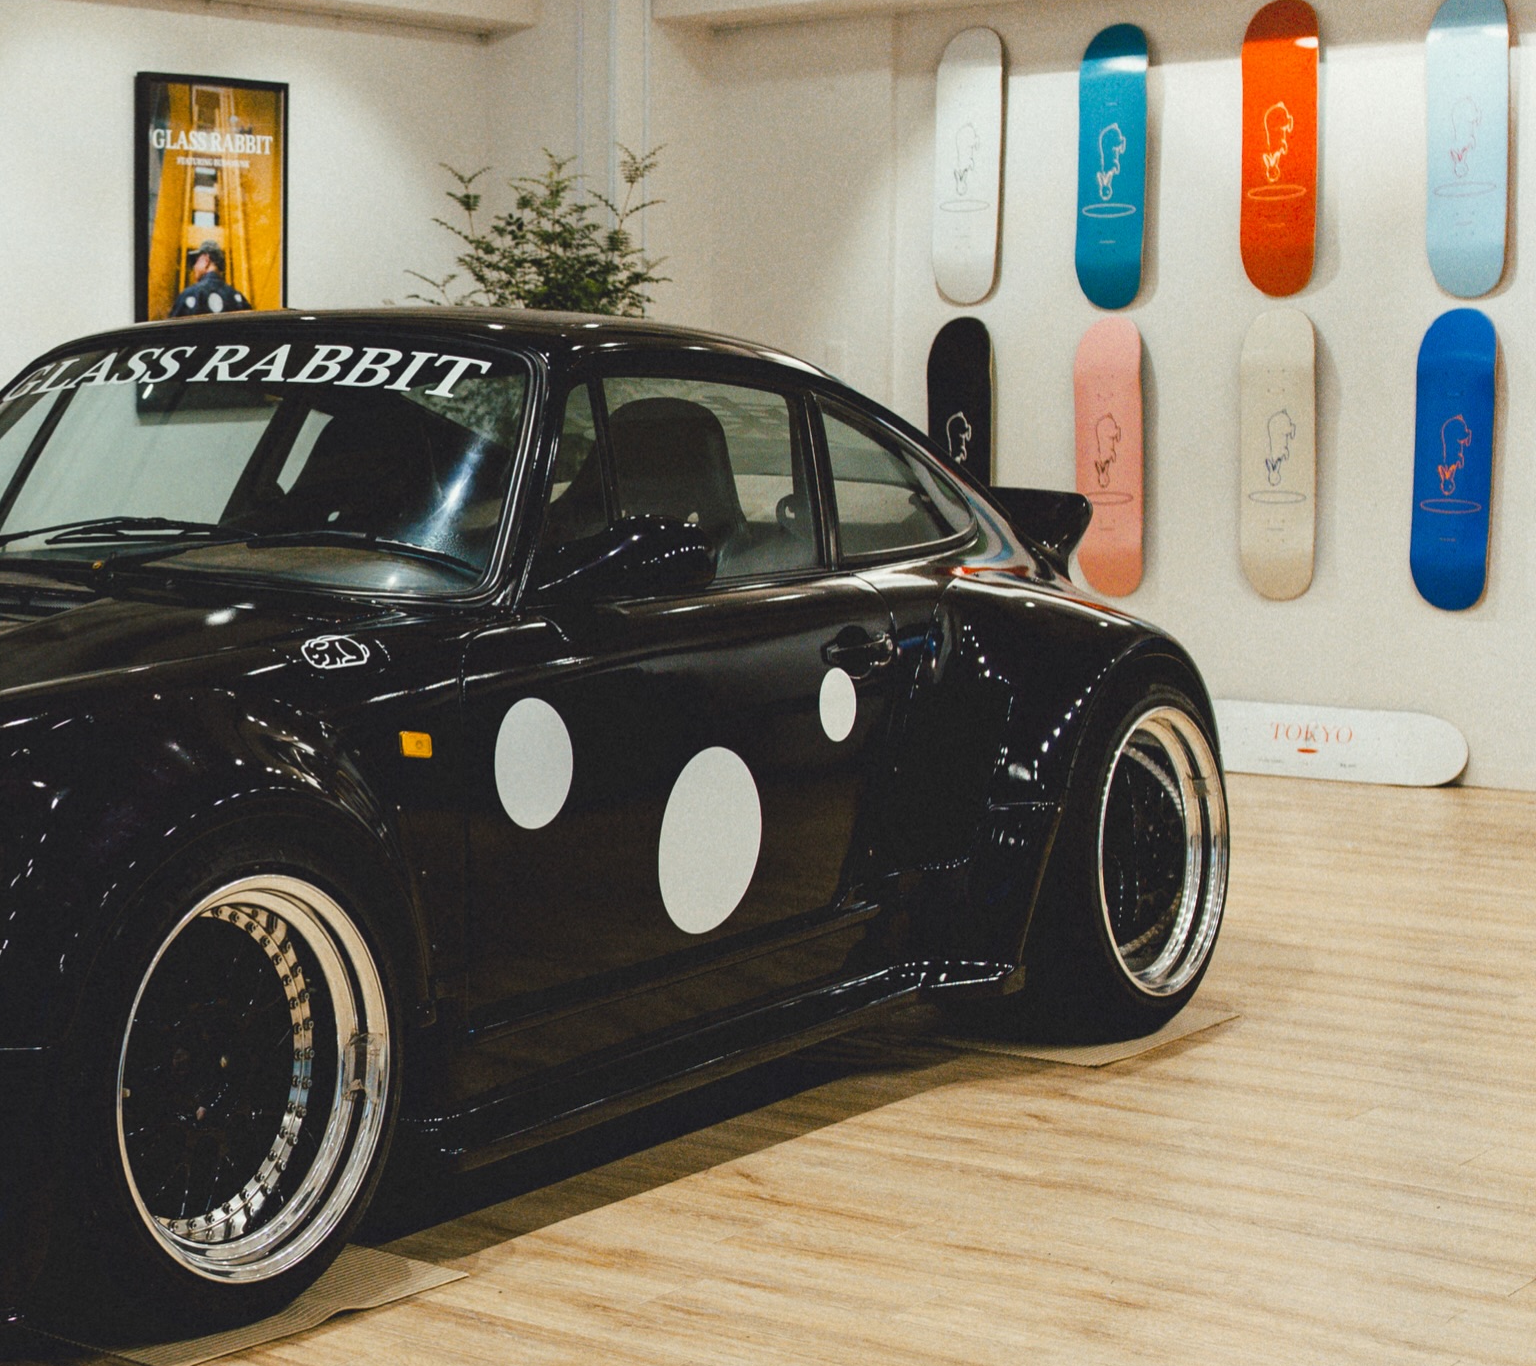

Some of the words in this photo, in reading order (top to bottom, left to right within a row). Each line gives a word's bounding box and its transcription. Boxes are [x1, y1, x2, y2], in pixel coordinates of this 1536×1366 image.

[152, 129, 210, 151] GLASS
[210, 133, 274, 155] RABBIT
[2, 346, 197, 402] GLASS
[186, 344, 492, 399] RABBIT
[1270, 722, 1353, 744] TOKYO
